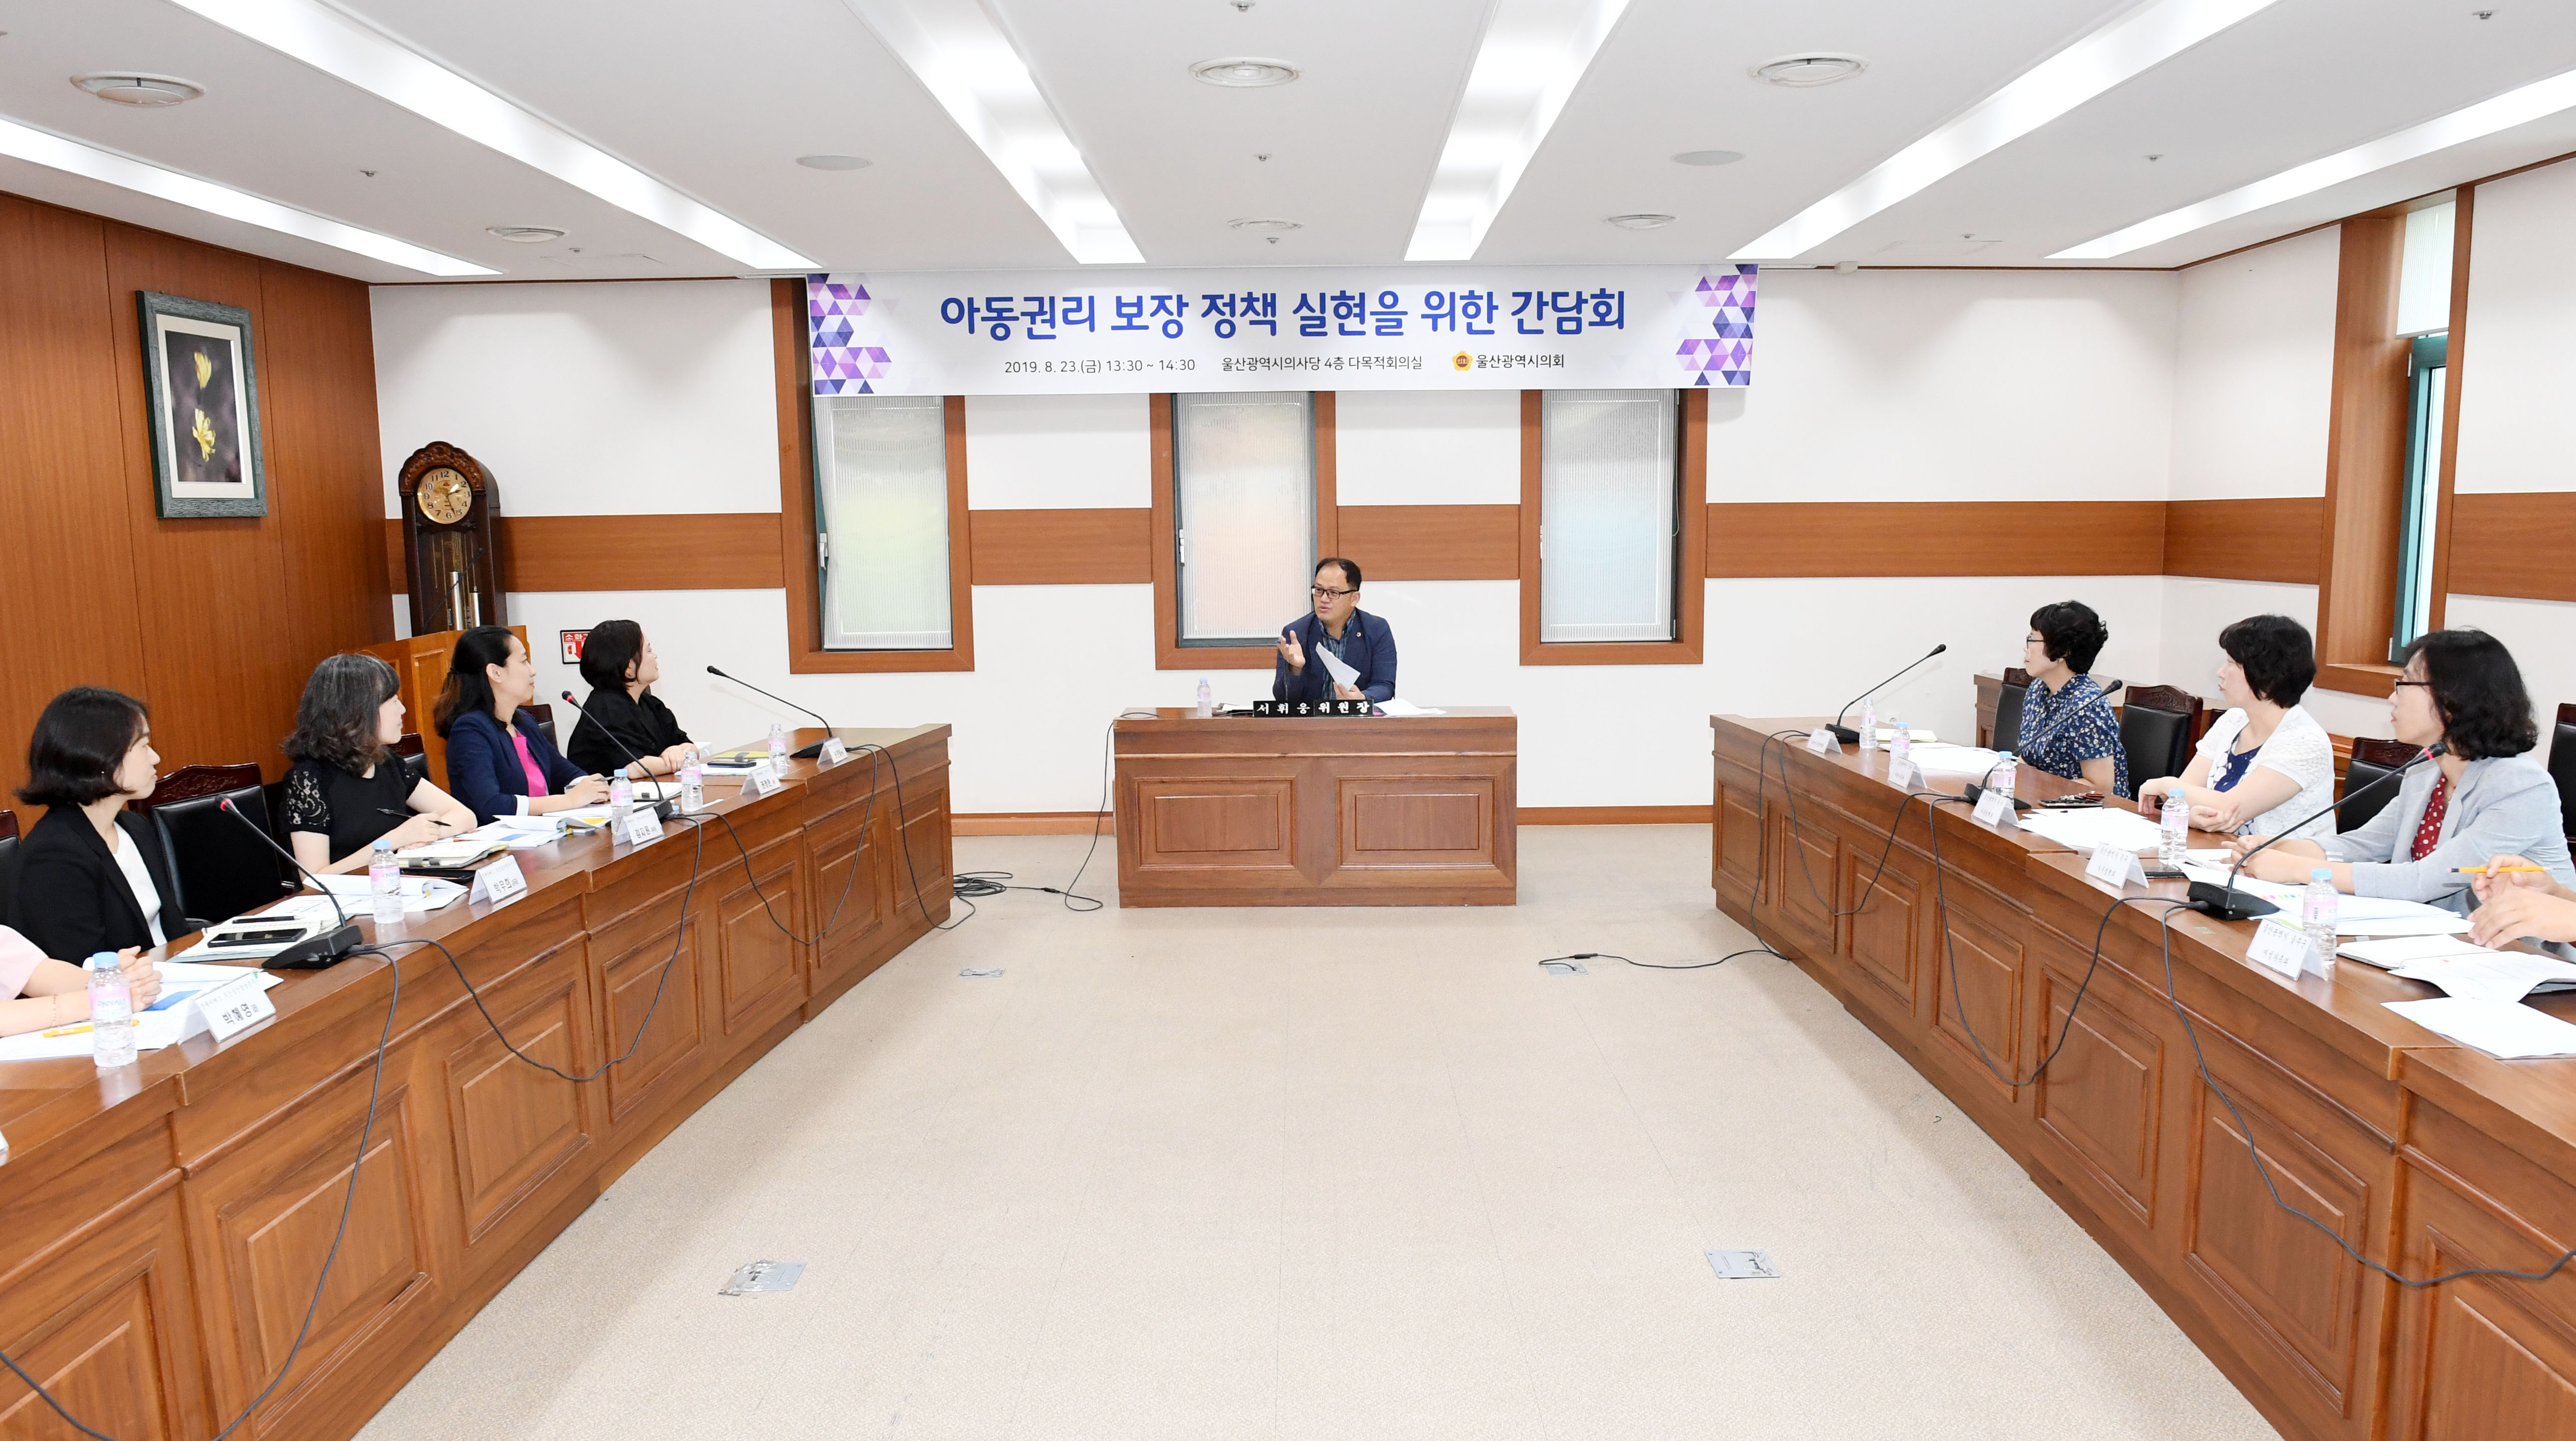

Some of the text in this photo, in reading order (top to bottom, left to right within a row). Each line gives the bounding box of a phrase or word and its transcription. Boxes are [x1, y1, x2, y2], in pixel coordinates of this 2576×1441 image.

[941, 288, 1625, 341] 아동권리 보장 정책 실현을 위한 간담회
[1004, 361, 1041, 373] 2019.
[1044, 361, 1056, 373] 8.
[1060, 360, 1101, 374] 23.(금)
[1106, 360, 1143, 372] 13:30
[1158, 359, 1195, 371] 14:30
[1221, 355, 1422, 372] 울산광역시의사당 4층 다목적회의실
[1476, 354, 1564, 369] 울산광역시의회
[1256, 701, 1370, 715] 서휘웅 위원장
